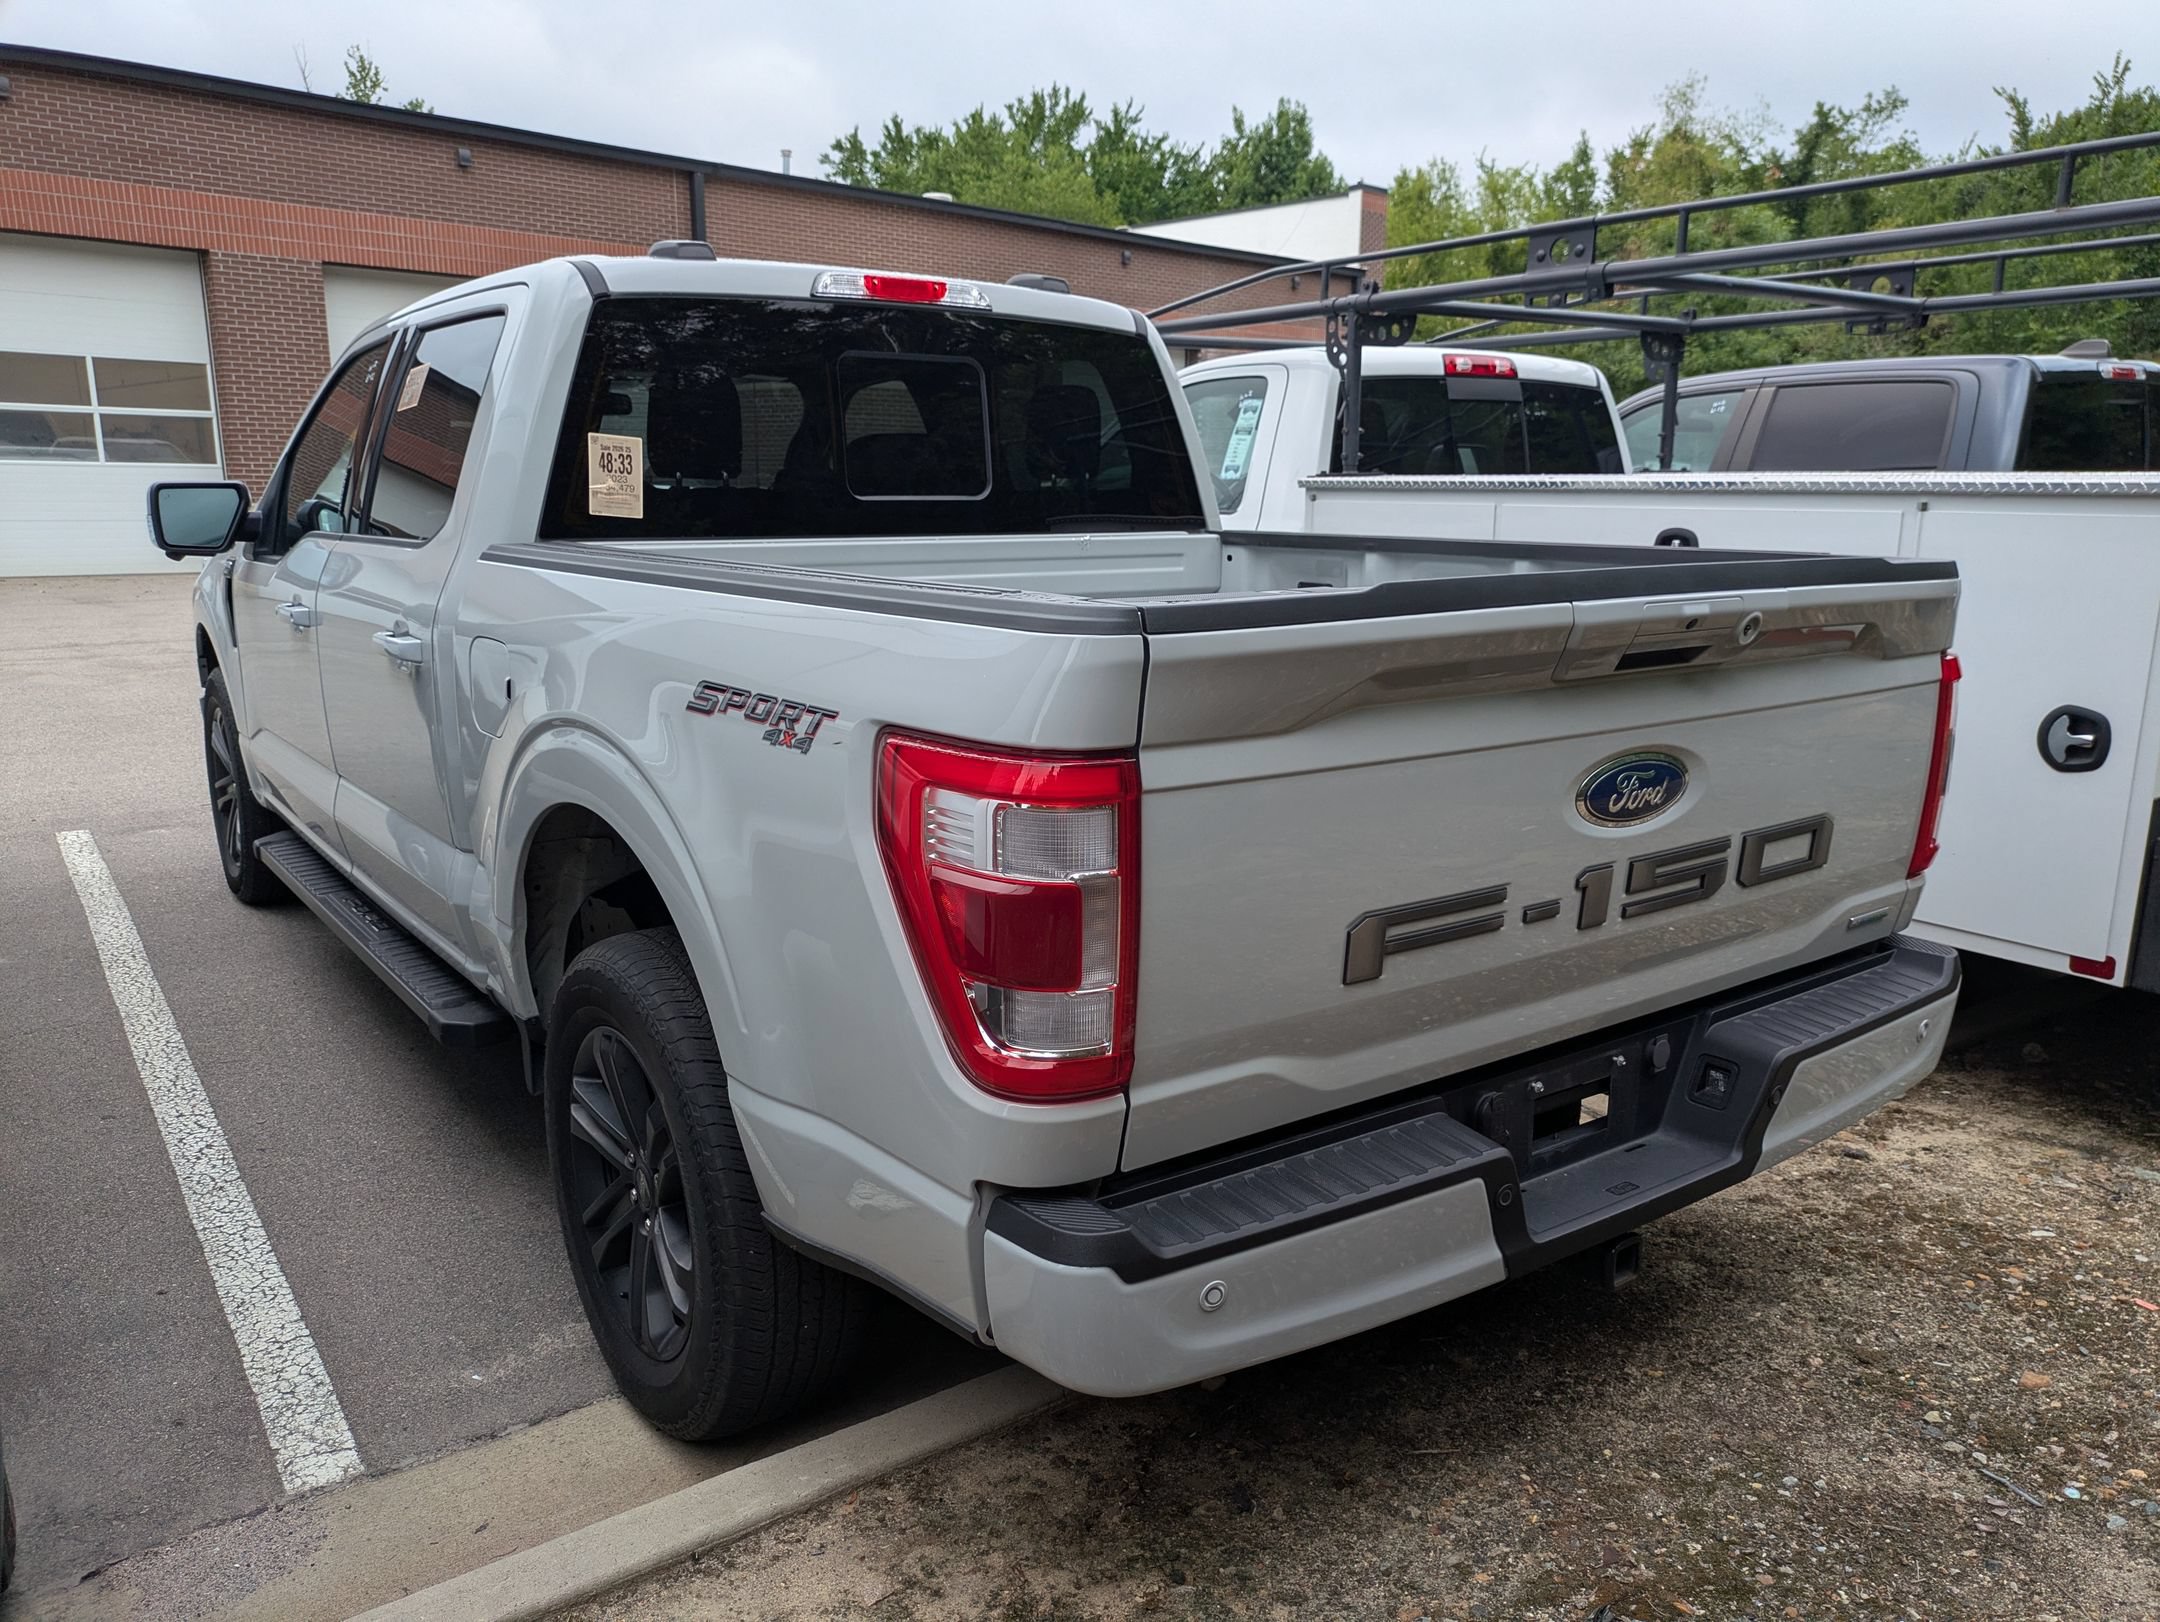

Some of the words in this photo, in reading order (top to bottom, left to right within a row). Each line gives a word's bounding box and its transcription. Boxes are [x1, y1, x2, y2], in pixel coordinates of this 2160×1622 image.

[598, 452, 633, 475] 48:33
[685, 679, 840, 737] SPORT
[1608, 770, 1670, 813] Ford
[1342, 813, 1834, 986] F-150
